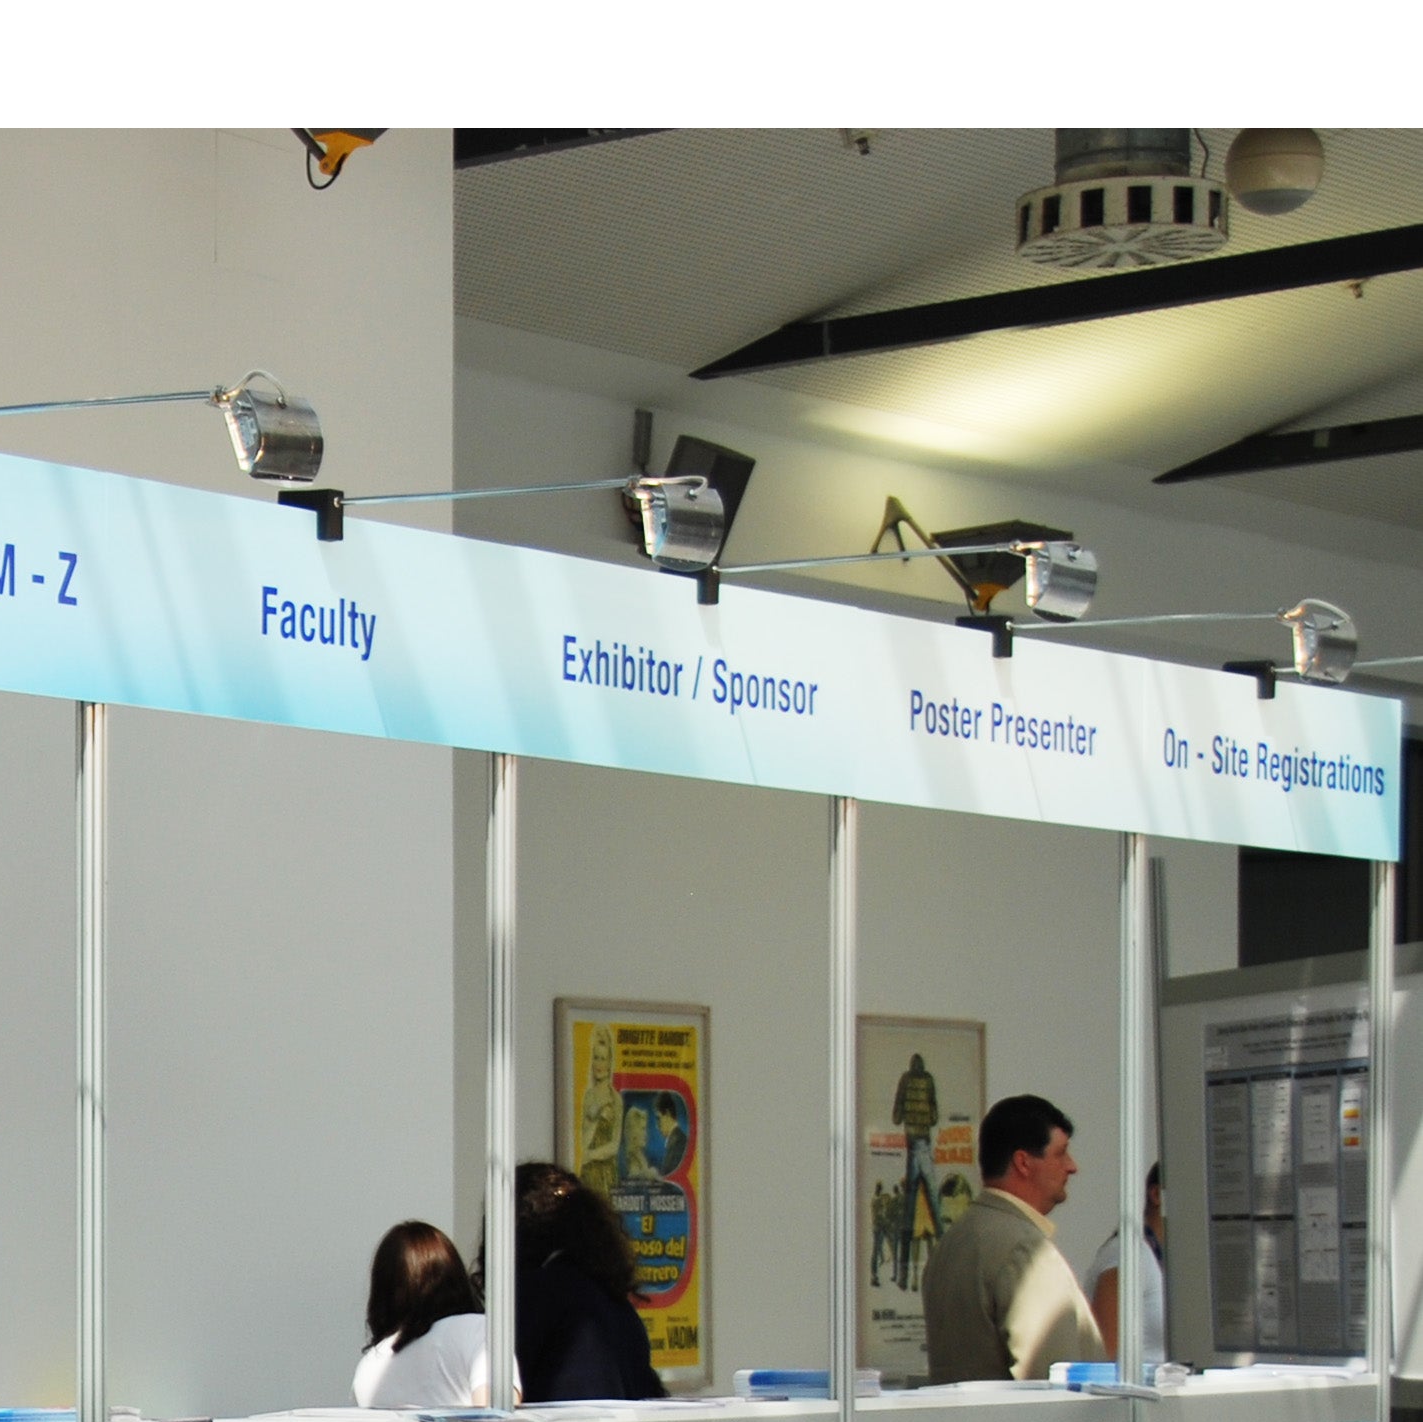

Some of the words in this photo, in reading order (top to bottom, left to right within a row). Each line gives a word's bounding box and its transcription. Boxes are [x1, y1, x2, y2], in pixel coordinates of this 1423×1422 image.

[32, 574, 45, 584] -
[58, 551, 78, 606] Z
[262, 586, 376, 661] Faculty
[563, 635, 683, 697] Exhibitor
[691, 656, 702, 700] /
[712, 658, 818, 716] Sponsor
[910, 690, 982, 740] Poster
[991, 702, 1097, 756] Presenter
[1163, 728, 1188, 769] On
[1212, 735, 1248, 778] Site
[1256, 742, 1385, 796] Registrations
[631, 1239, 663, 1257] poso
[665, 1236, 686, 1258] del
[634, 1265, 679, 1283] uerrero
